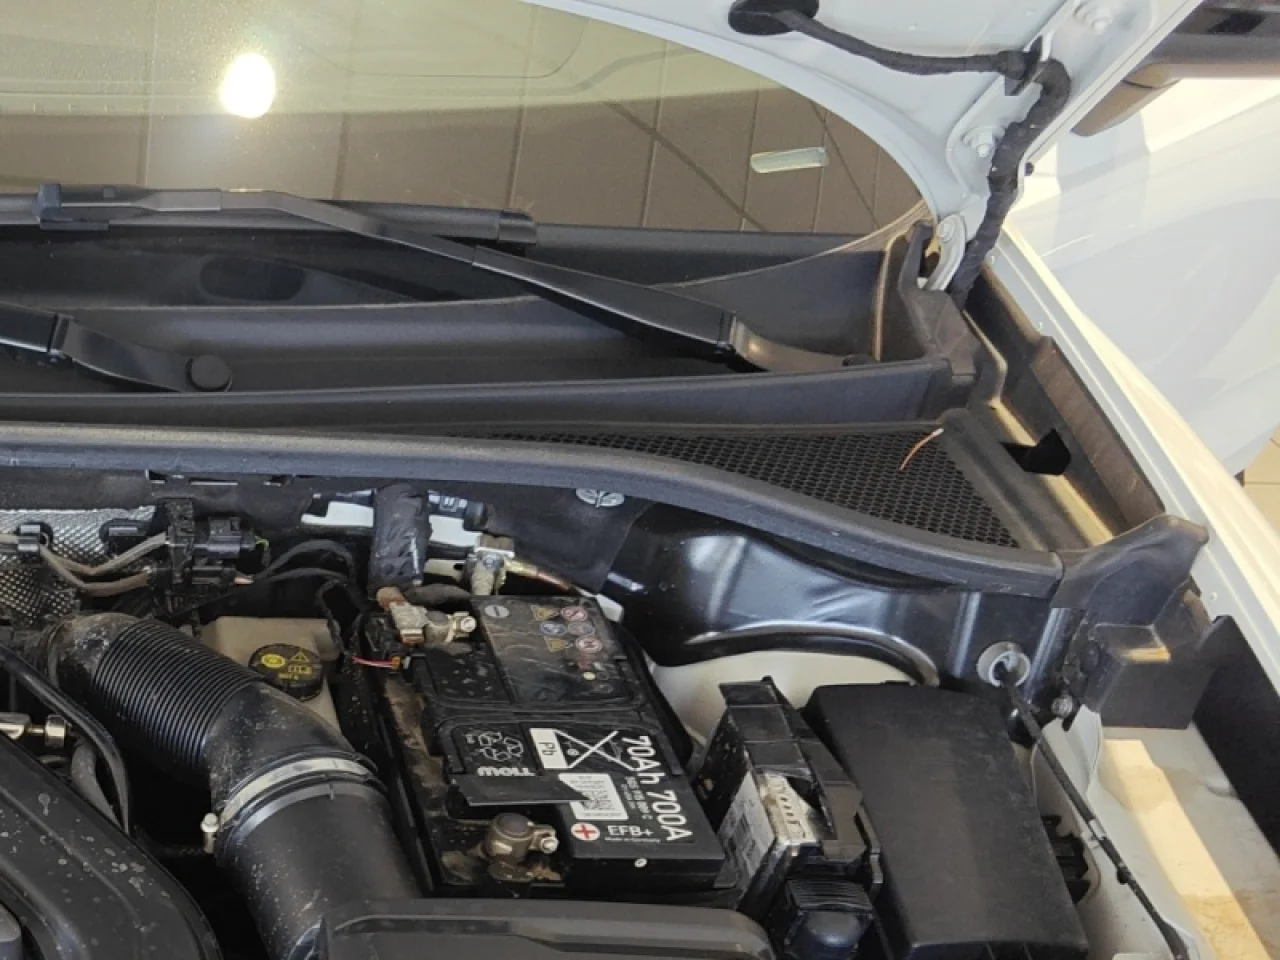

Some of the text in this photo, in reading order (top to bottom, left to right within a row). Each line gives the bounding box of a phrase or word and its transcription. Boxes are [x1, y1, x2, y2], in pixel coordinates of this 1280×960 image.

[622, 735, 666, 785] 70Ah
[646, 789, 693, 841] 700A
[607, 825, 654, 836] EFB+
